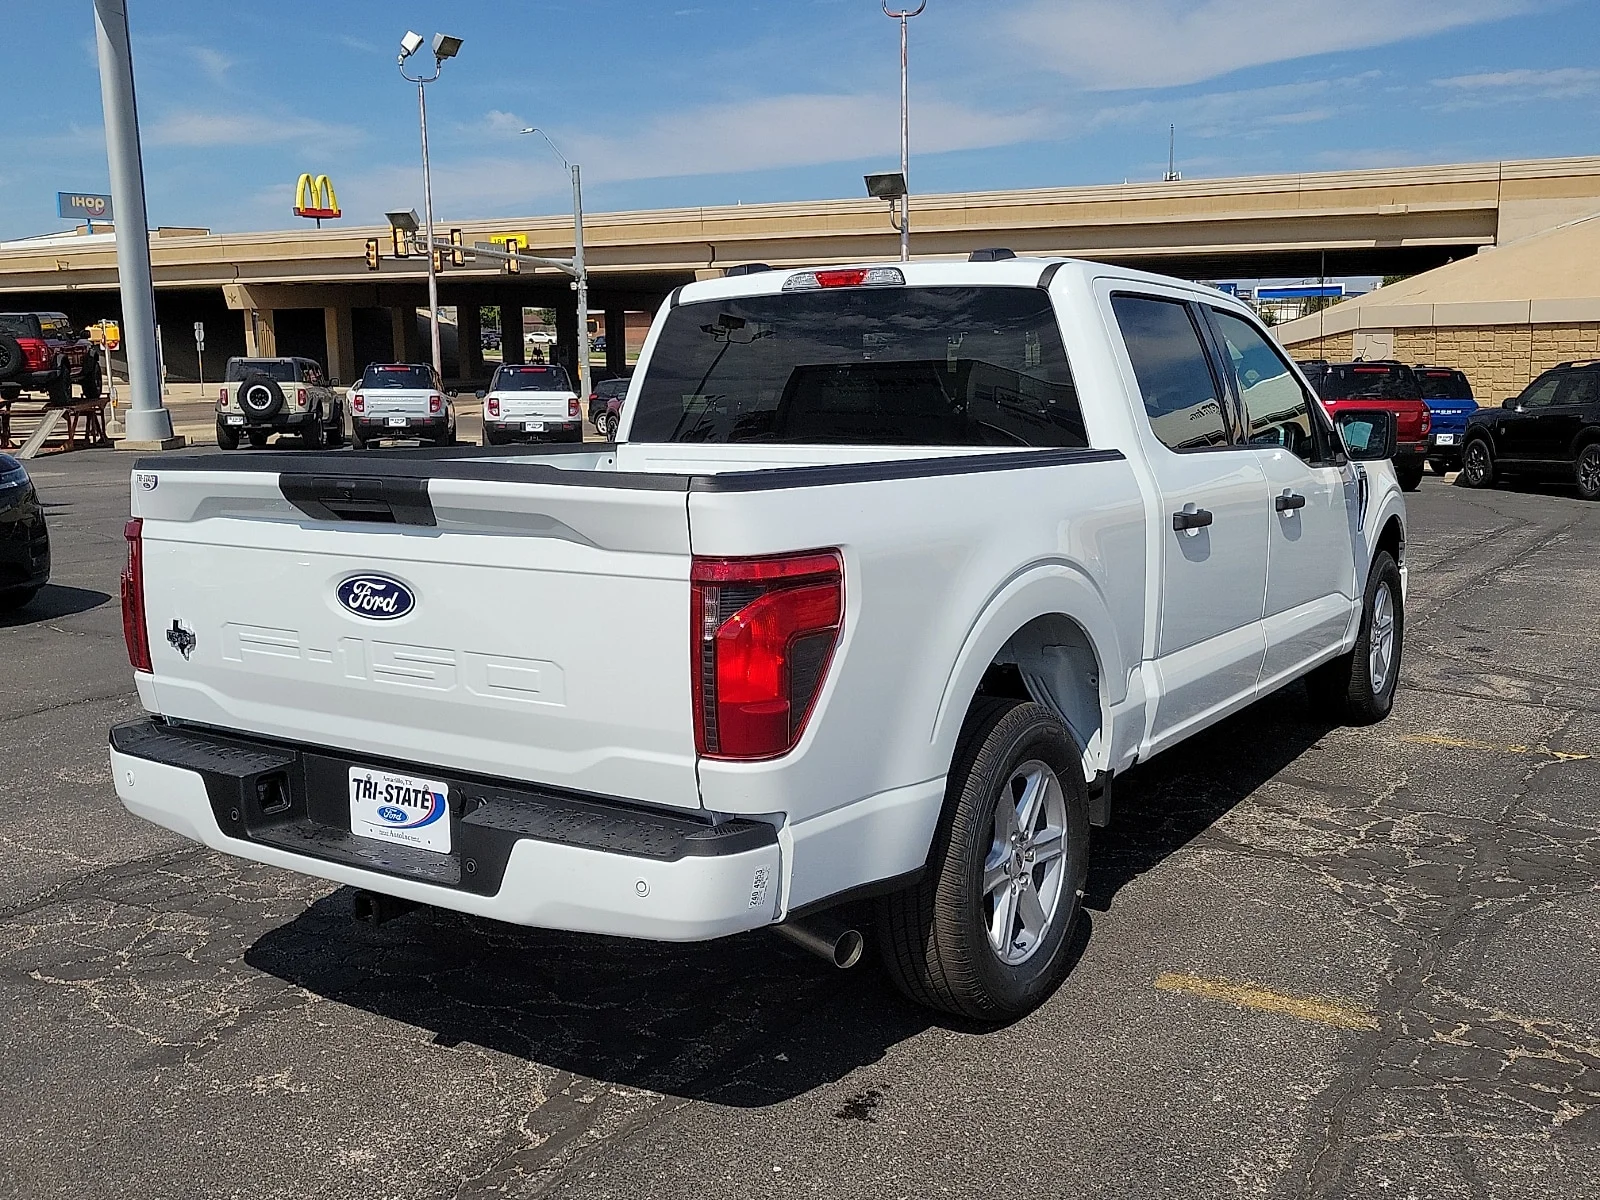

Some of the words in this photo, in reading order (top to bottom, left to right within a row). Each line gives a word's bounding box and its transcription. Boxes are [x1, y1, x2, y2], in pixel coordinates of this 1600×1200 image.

[348, 580, 399, 613] Ford
[221, 621, 567, 708] F-150
[352, 778, 430, 811] TRI-STATE
[383, 807, 402, 821] Ford
